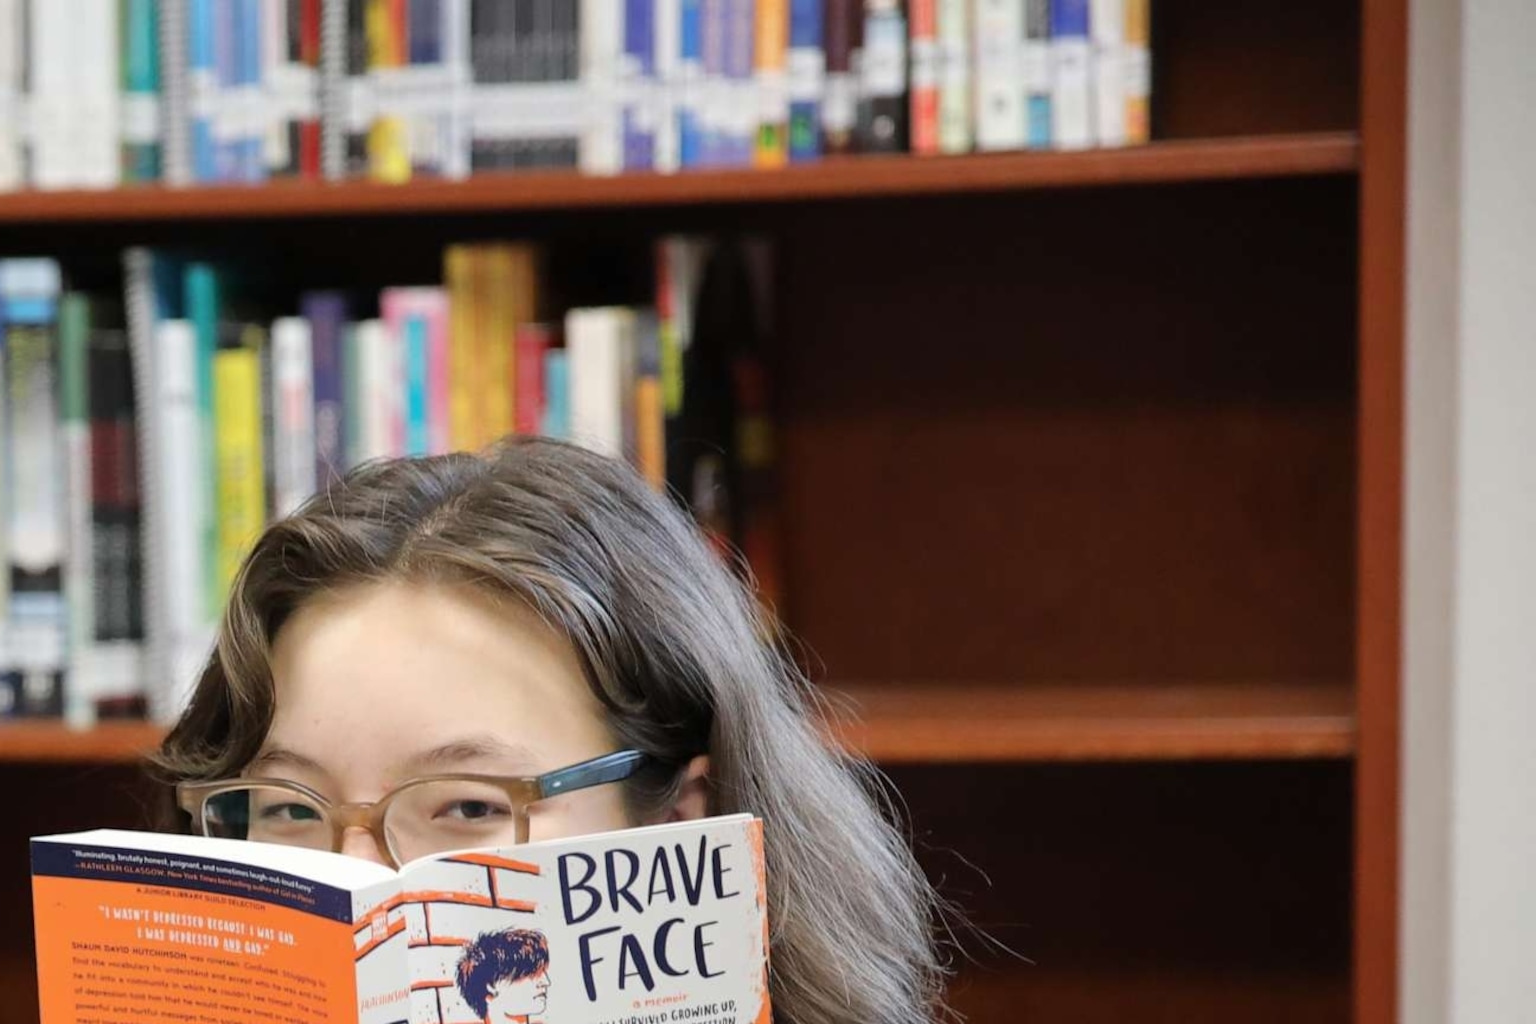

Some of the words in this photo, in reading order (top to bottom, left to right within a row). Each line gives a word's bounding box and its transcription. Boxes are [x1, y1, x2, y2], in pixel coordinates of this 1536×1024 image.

[558, 835, 740, 925] BRAVE
[144, 928, 164, 941] WAS
[256, 925, 274, 940] WAS
[579, 918, 726, 1002] FACE
[644, 993, 689, 1007] memoir
[670, 1003, 718, 1022] GROWING
[721, 1000, 736, 1014] UP,
